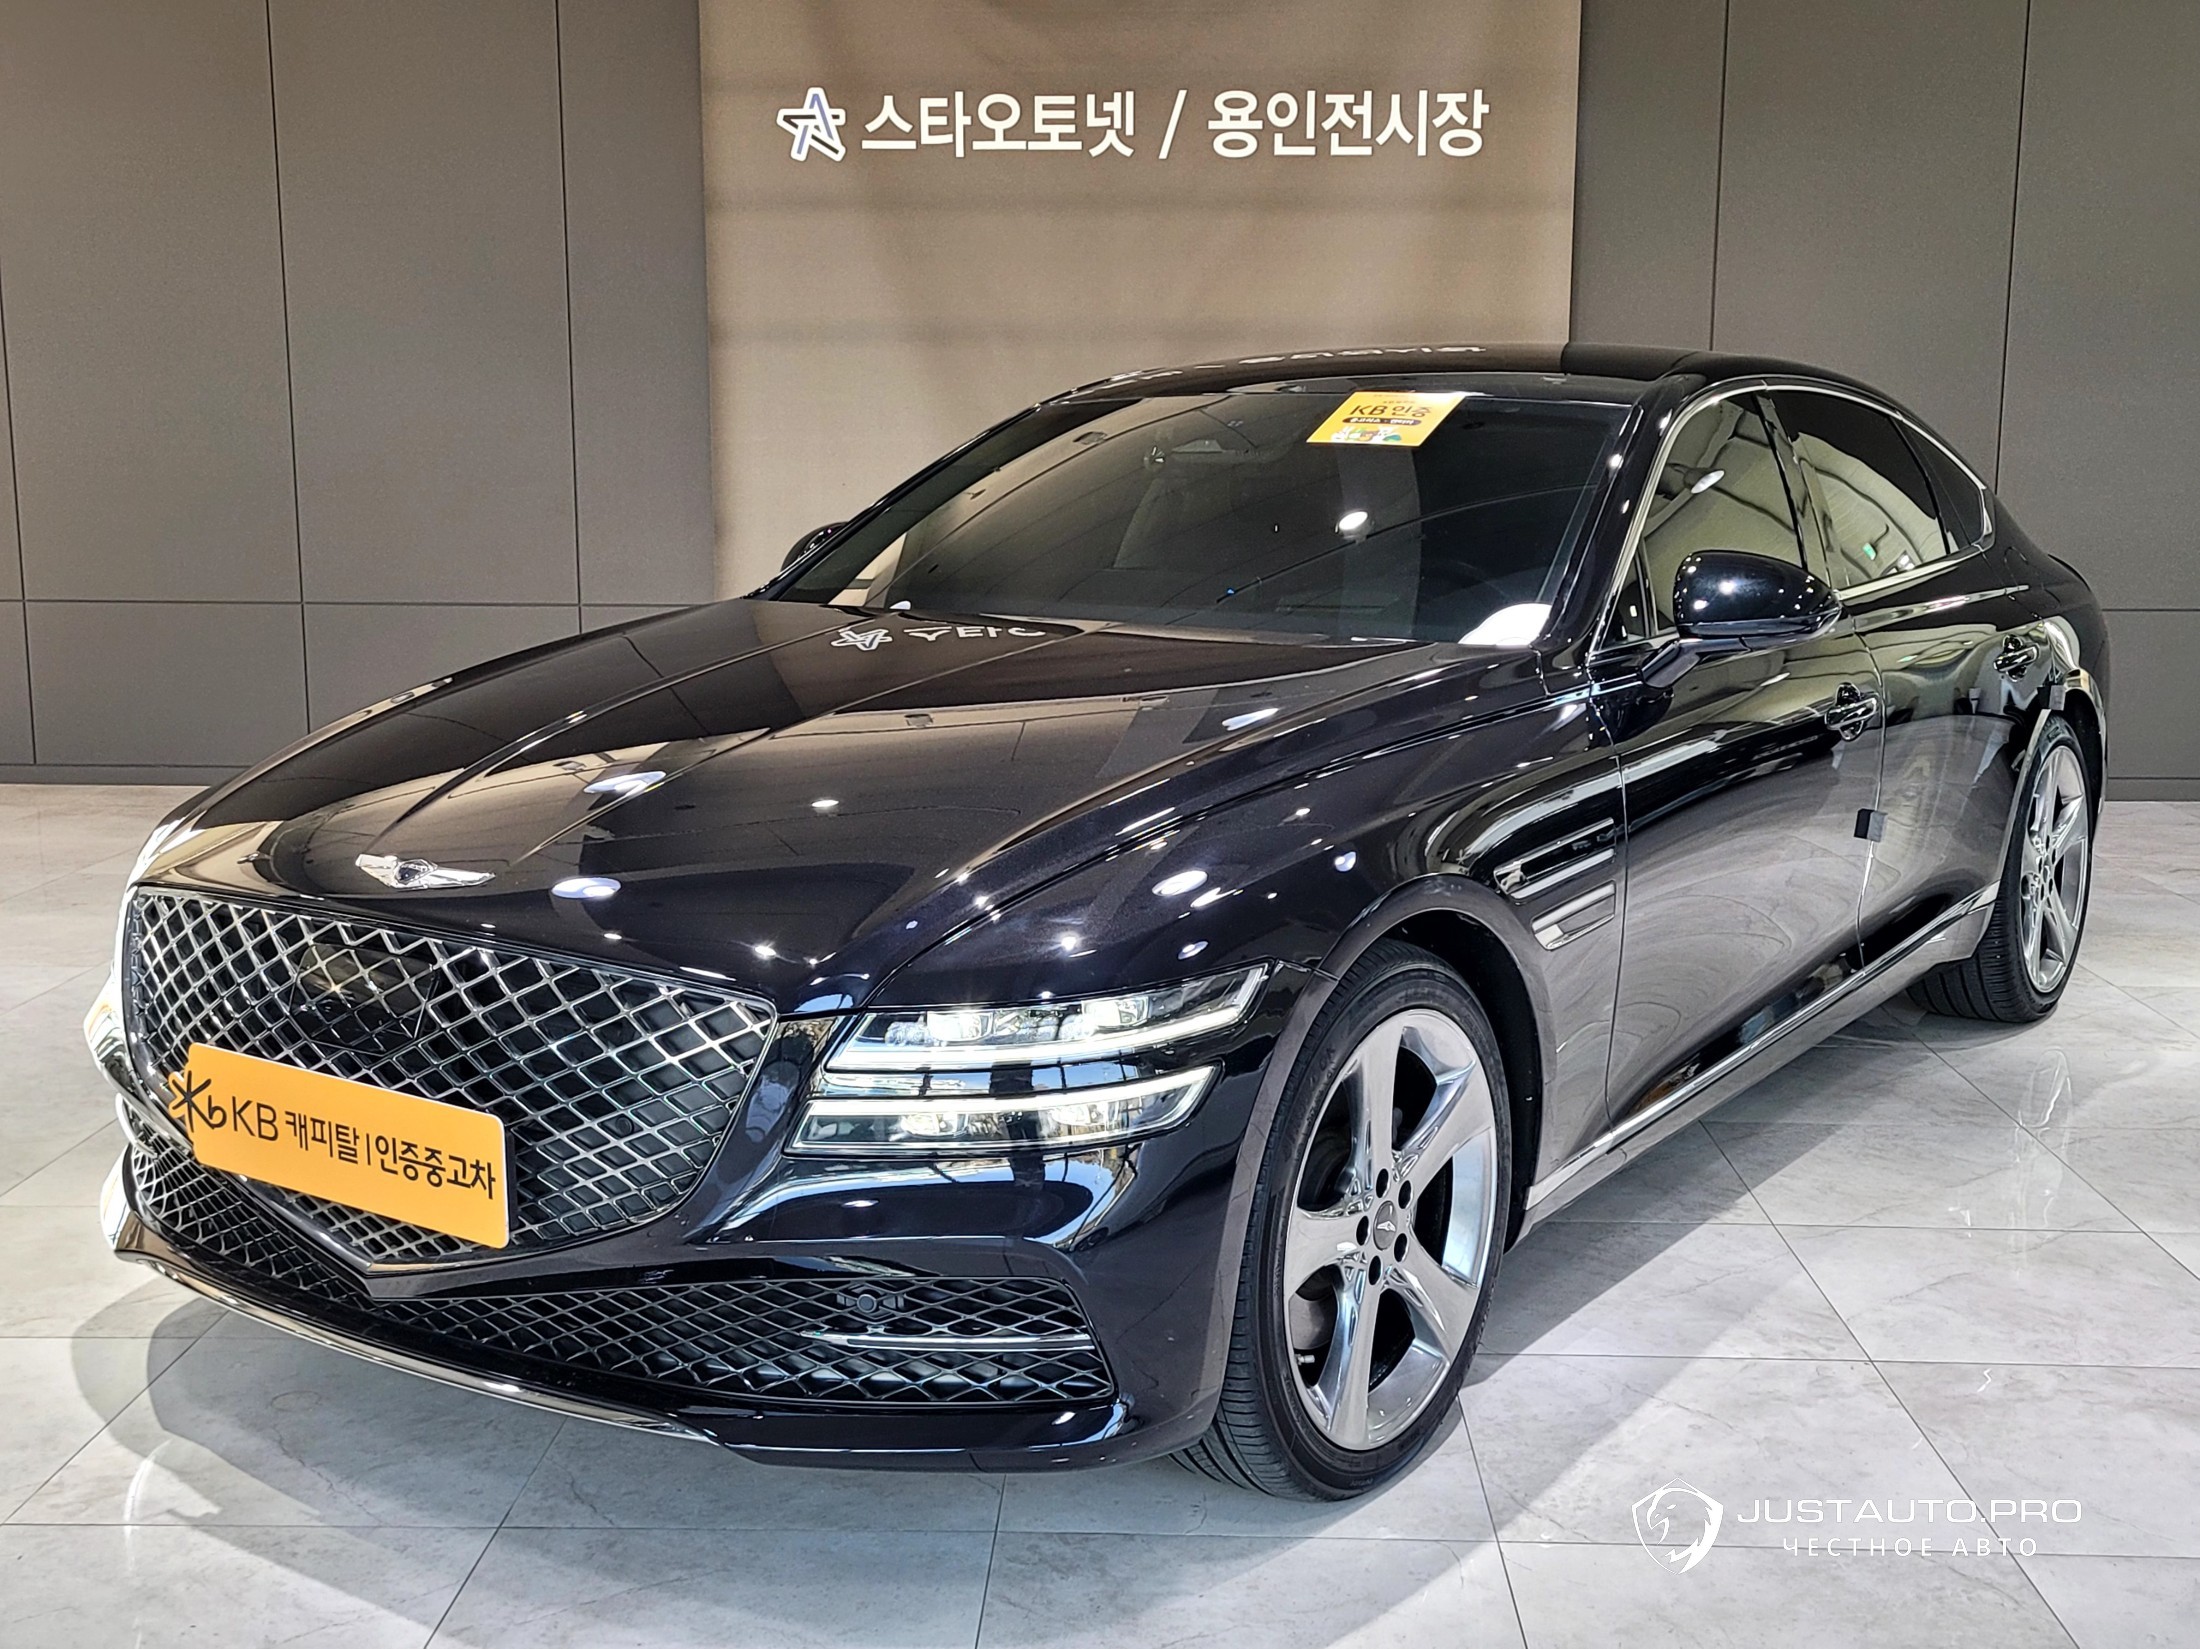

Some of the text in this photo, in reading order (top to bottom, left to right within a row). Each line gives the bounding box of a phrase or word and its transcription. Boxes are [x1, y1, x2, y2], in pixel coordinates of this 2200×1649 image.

[861, 90, 1135, 158] 스타오토넷
[1207, 88, 1490, 158] 용인전시장
[1349, 405, 1432, 418] KB 인증
[231, 1095, 280, 1142] KB
[285, 1110, 360, 1165] 캐피탈
[374, 1134, 497, 1200] 인증중고차
